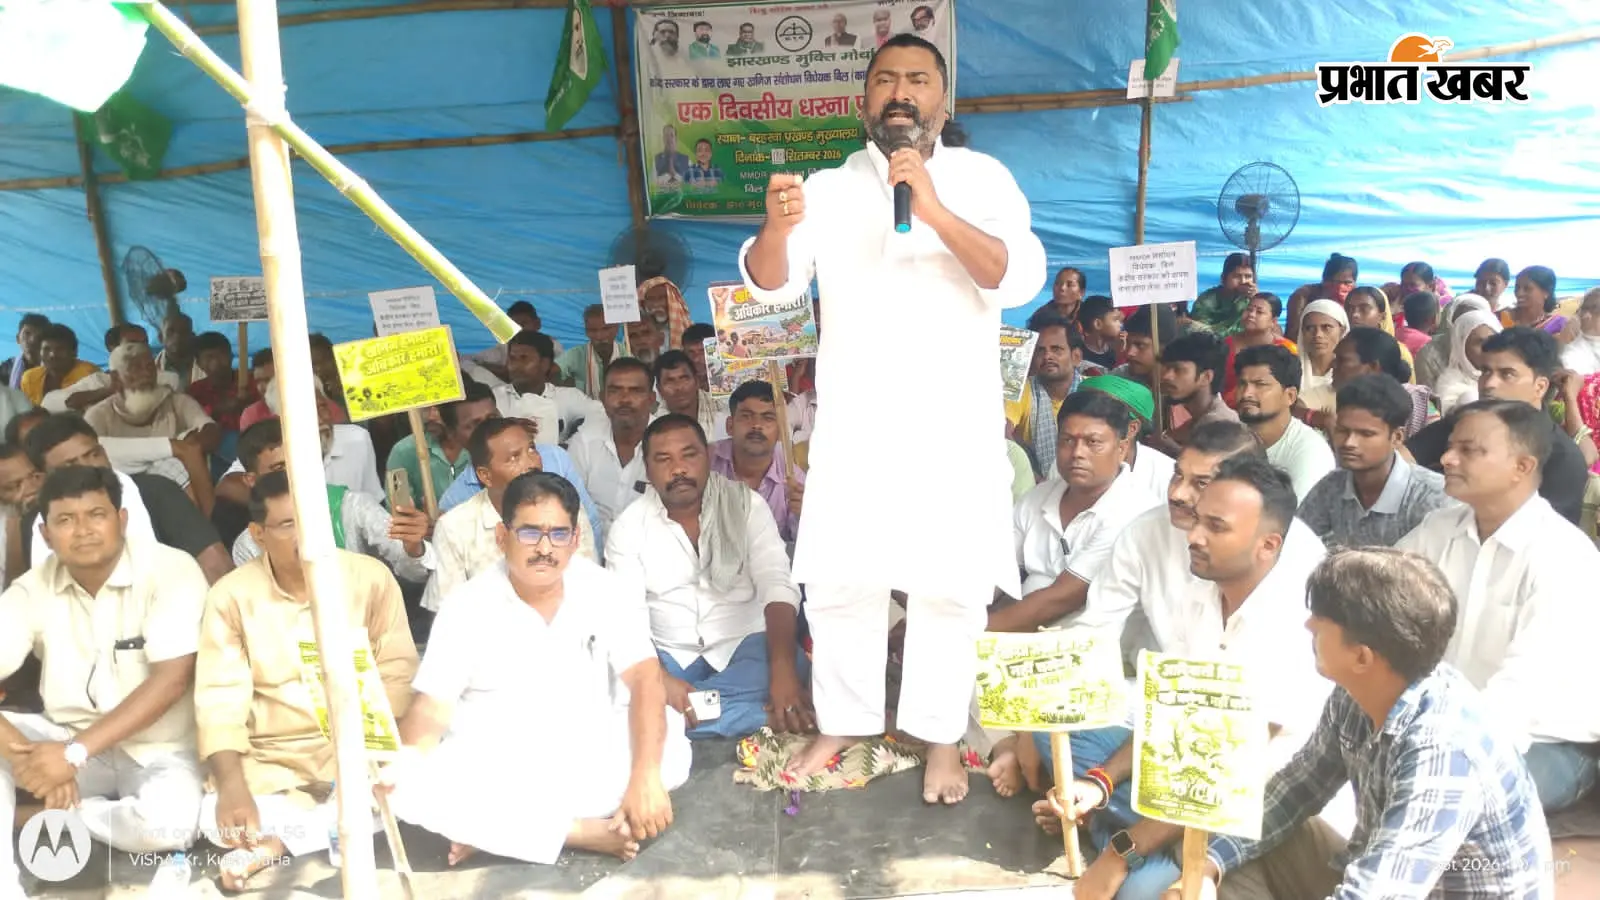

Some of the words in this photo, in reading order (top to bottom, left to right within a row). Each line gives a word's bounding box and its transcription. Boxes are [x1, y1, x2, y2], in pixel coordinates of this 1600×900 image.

[727, 55, 790, 67] झारखण्ड
[796, 50, 836, 67] मुक्ति
[664, 78, 690, 88] सरकार
[747, 73, 771, 87] खनिज
[774, 72, 801, 85] संशोधन
[804, 70, 832, 82] विधेयक
[834, 68, 849, 81] बिल
[676, 101, 713, 123] एक
[718, 92, 793, 120] दिवसीय
[799, 95, 850, 117] धरना
[816, 128, 859, 146] मुख्यालय
[786, 149, 821, 162] सितम्बर
[734, 303, 770, 321] अधिकार
